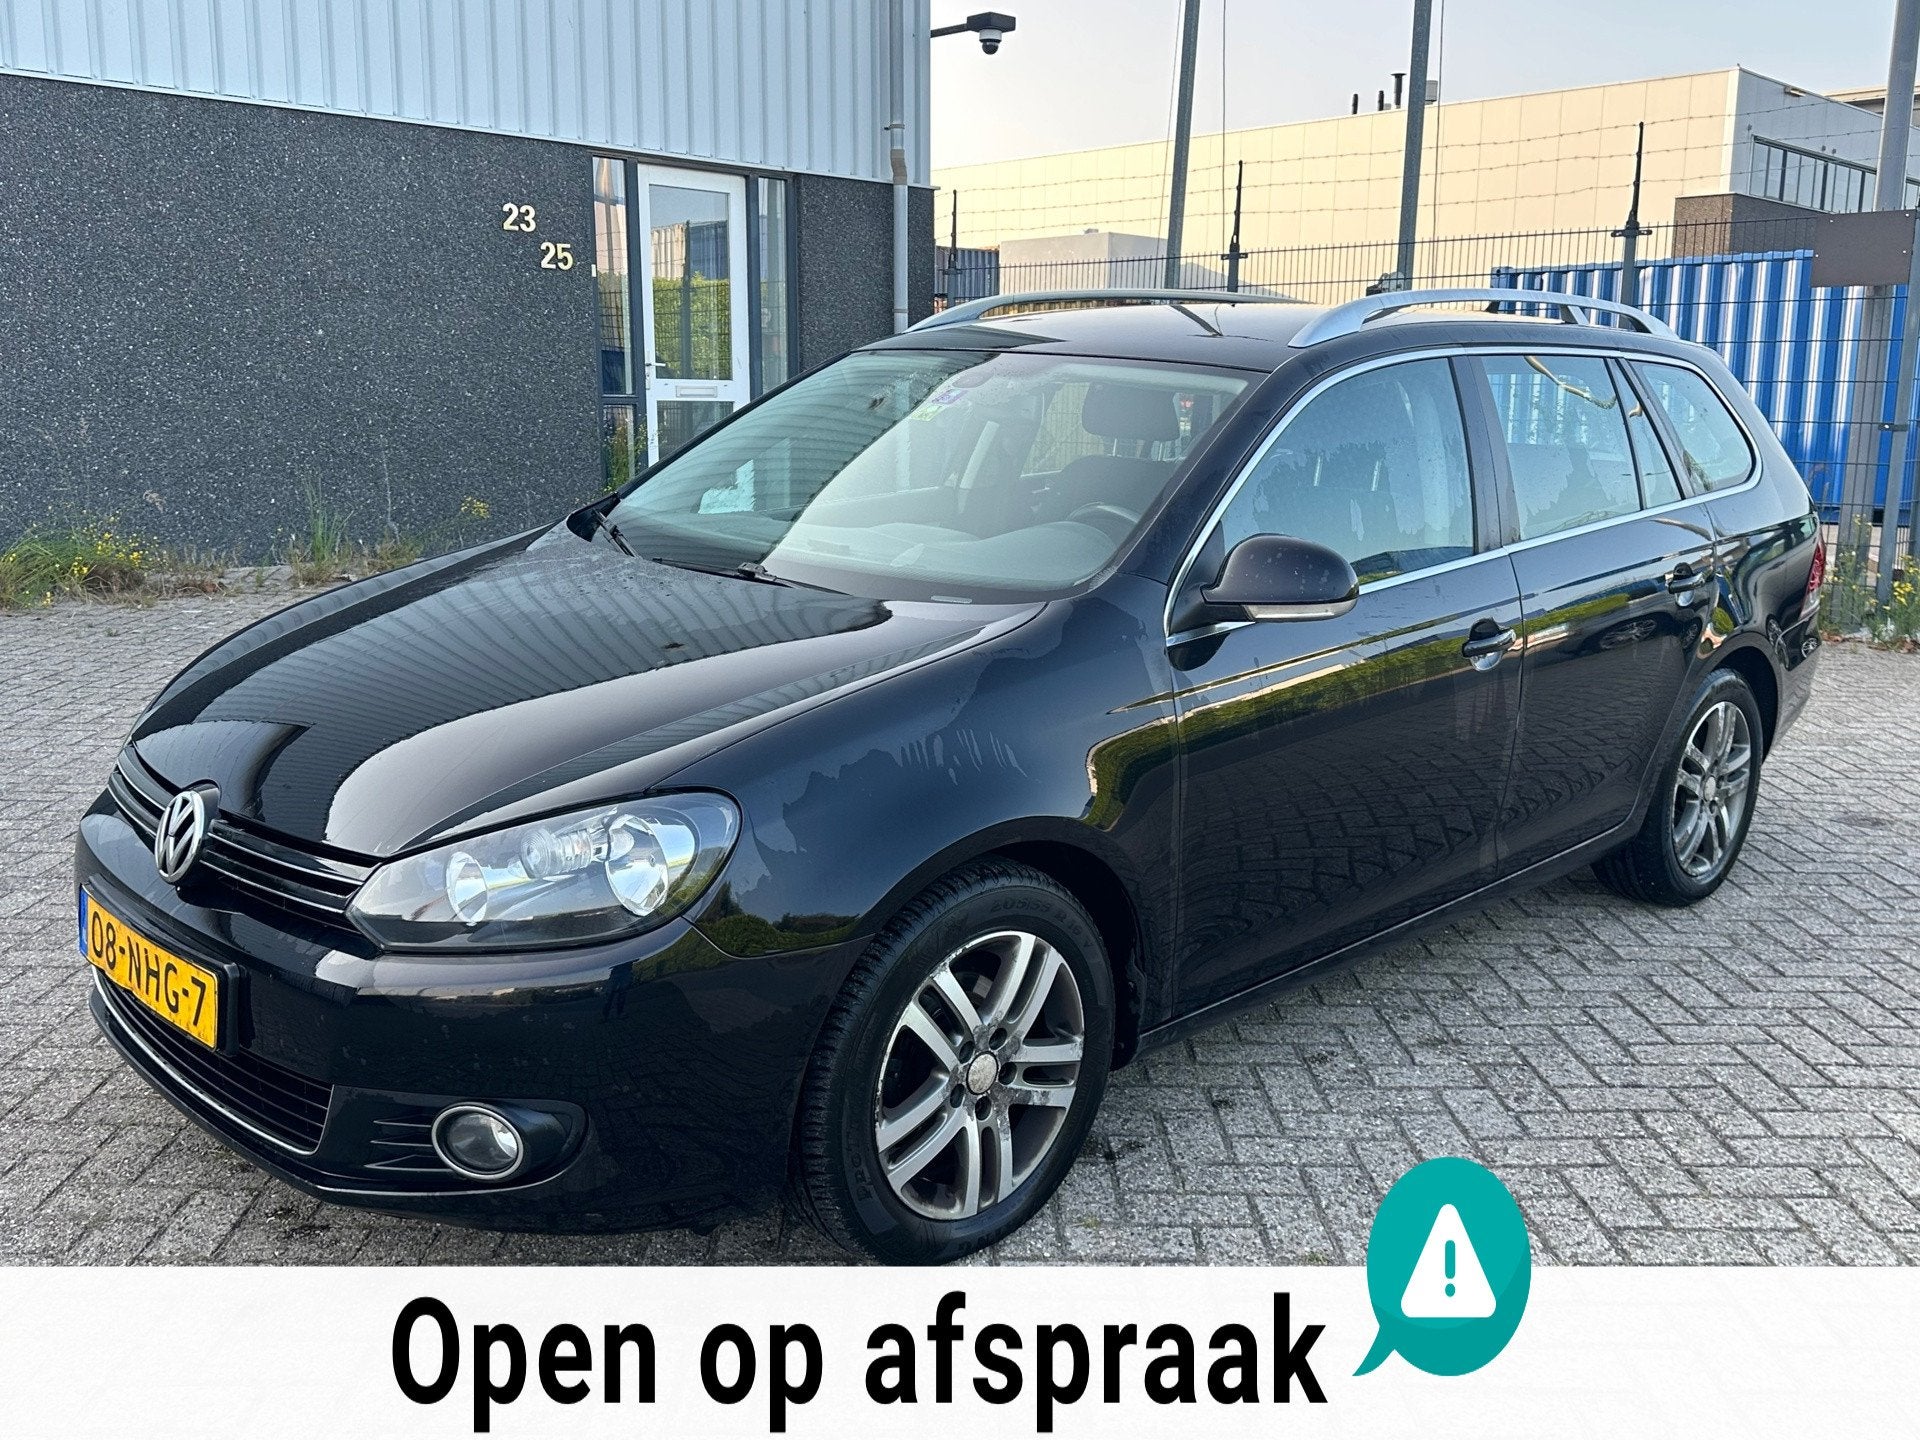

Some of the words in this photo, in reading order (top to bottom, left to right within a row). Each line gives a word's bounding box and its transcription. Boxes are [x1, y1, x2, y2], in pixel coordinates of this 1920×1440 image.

[502, 202, 536, 232] 23
[540, 241, 574, 271] 25
[91, 910, 207, 1027] 08-NHG-7
